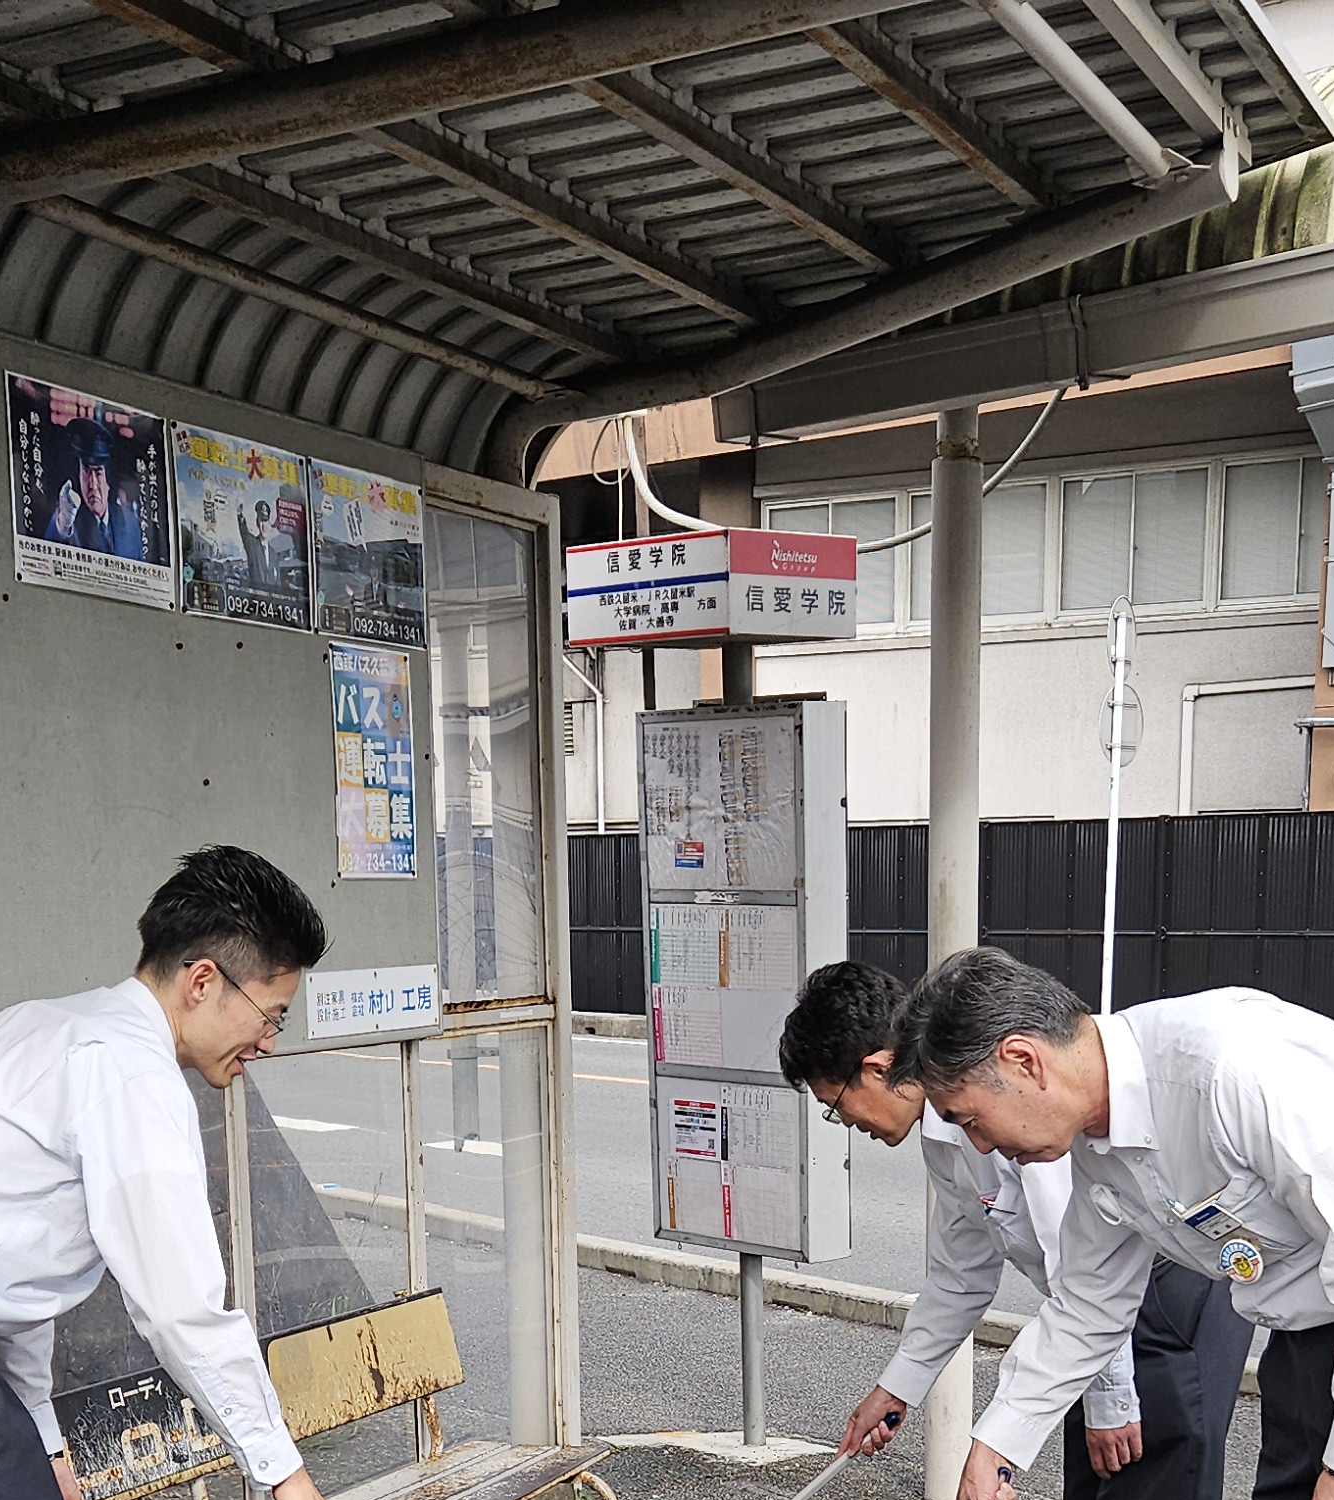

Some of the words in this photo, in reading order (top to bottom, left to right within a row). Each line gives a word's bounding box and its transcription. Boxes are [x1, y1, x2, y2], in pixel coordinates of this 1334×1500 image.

[606, 543, 686, 574] 信愛学院
[771, 547, 818, 564] Nishitetsu
[782, 562, 816, 573] Group
[227, 596, 305, 625] 092-734-1341
[697, 597, 717, 611] 方面
[745, 584, 847, 616] 信愛学院
[353, 616, 421, 643] 092-734-1341
[337, 683, 384, 729] バス
[338, 736, 411, 786] 運転士
[341, 791, 413, 839] 大募集
[341, 851, 415, 872] 092-734-1341
